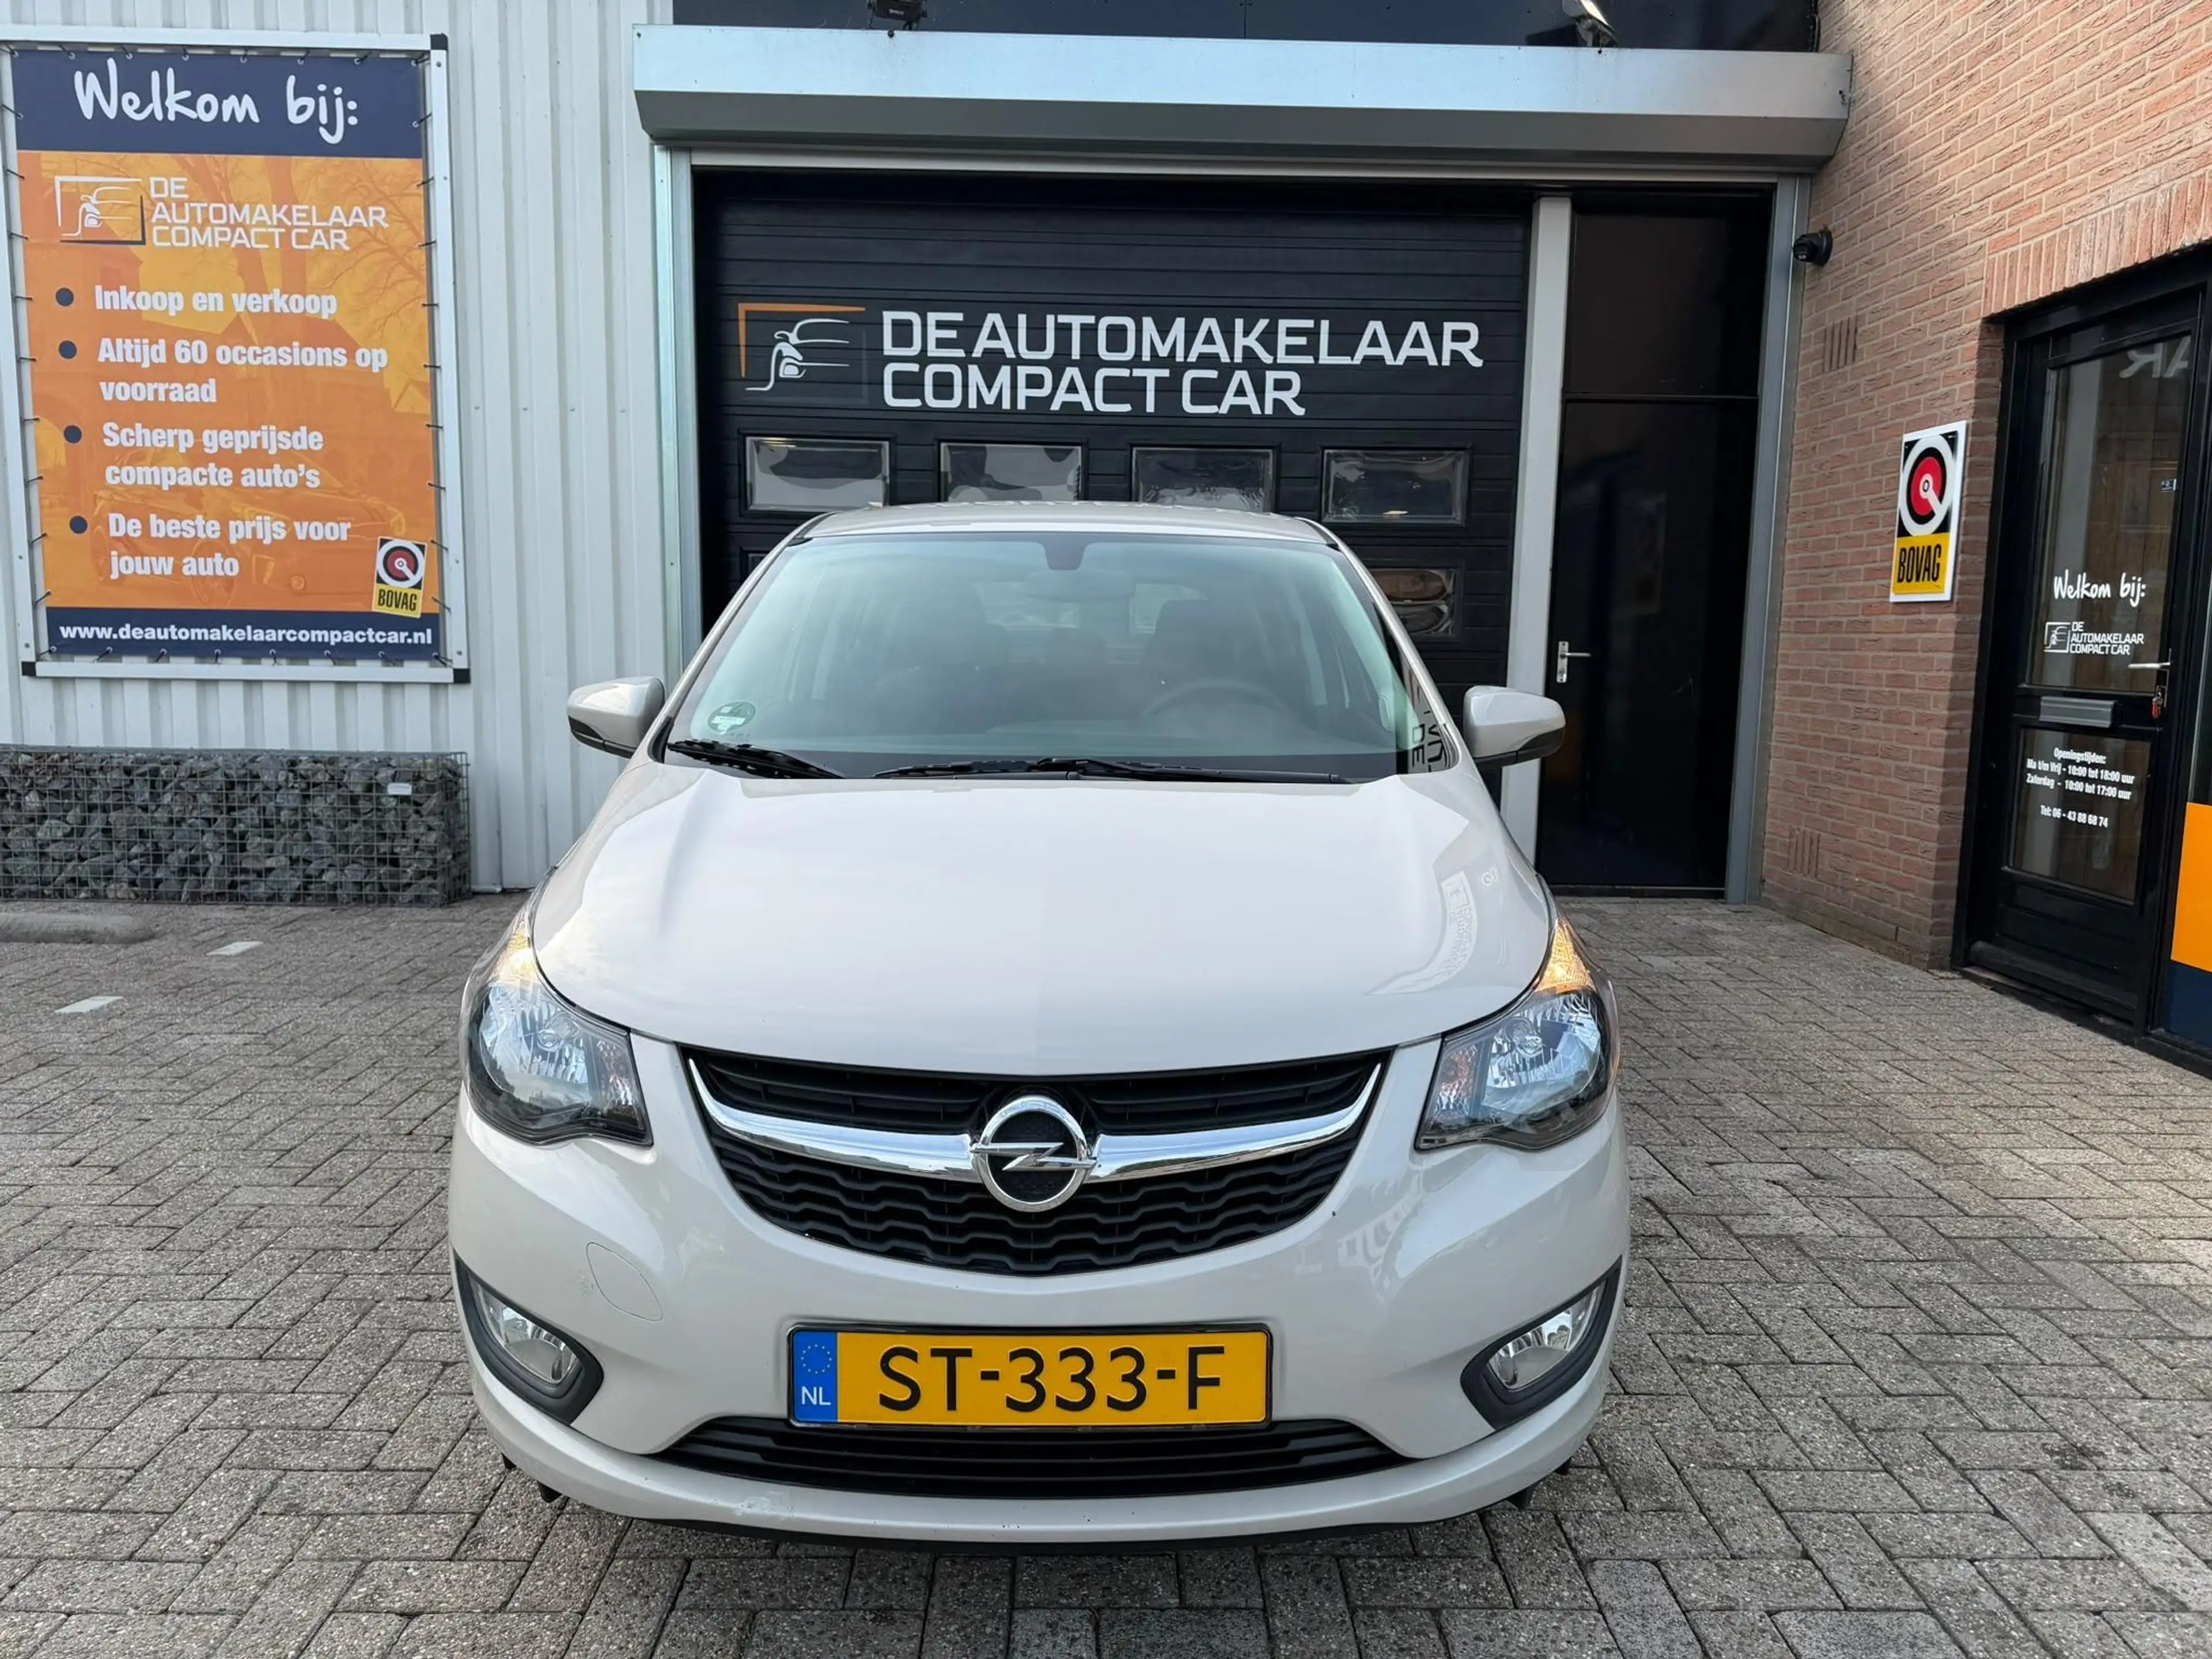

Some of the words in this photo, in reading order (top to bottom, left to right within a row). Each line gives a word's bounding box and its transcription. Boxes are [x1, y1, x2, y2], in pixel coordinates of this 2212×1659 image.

[74, 58, 260, 123] Welkom
[286, 75, 358, 144] bij:
[150, 177, 189, 199] DE
[152, 203, 389, 228] AUTOMAKELAAR
[153, 228, 286, 248] COMPACT
[291, 230, 350, 250] CAR
[96, 286, 183, 315] Inkoop
[192, 293, 224, 312] en
[232, 290, 337, 319] verkoop
[883, 311, 965, 357] DE
[972, 313, 1484, 367] AUTOMAKELAAR
[98, 338, 166, 368] Altijd
[175, 340, 208, 363] 60
[216, 341, 347, 367] occasions
[355, 347, 388, 372] op
[100, 379, 217, 402] voorraad
[883, 363, 1174, 412] COMPACT
[1181, 369, 1305, 416] CAR
[103, 422, 195, 453] Scherp
[203, 426, 324, 454] geprijsde
[105, 465, 232, 490] compacte
[241, 464, 320, 487] auto's
[108, 513, 142, 537] De
[150, 516, 220, 540] beste
[229, 517, 286, 544] prijs
[294, 521, 351, 541] voor
[110, 551, 173, 579] jouw
[183, 553, 240, 577] auto
[1896, 544, 1941, 583] BOVAG
[377, 589, 418, 612] BOVAG
[2054, 569, 2111, 600] Welkom
[2119, 573, 2146, 607] bij:
[59, 624, 432, 644] www.deautomakelaarcompactcar.nl
[2071, 622, 2084, 632] DE
[2071, 633, 2144, 645] AUTOMAKELAAR
[2070, 644, 2109, 654] COMPACT
[2110, 645, 2130, 656] CAR
[2054, 747, 2106, 764] Openingstijden:
[2121, 773, 2135, 784] uur
[878, 1346, 1225, 1412] ST-333-F
[801, 1386, 831, 1406] NL
